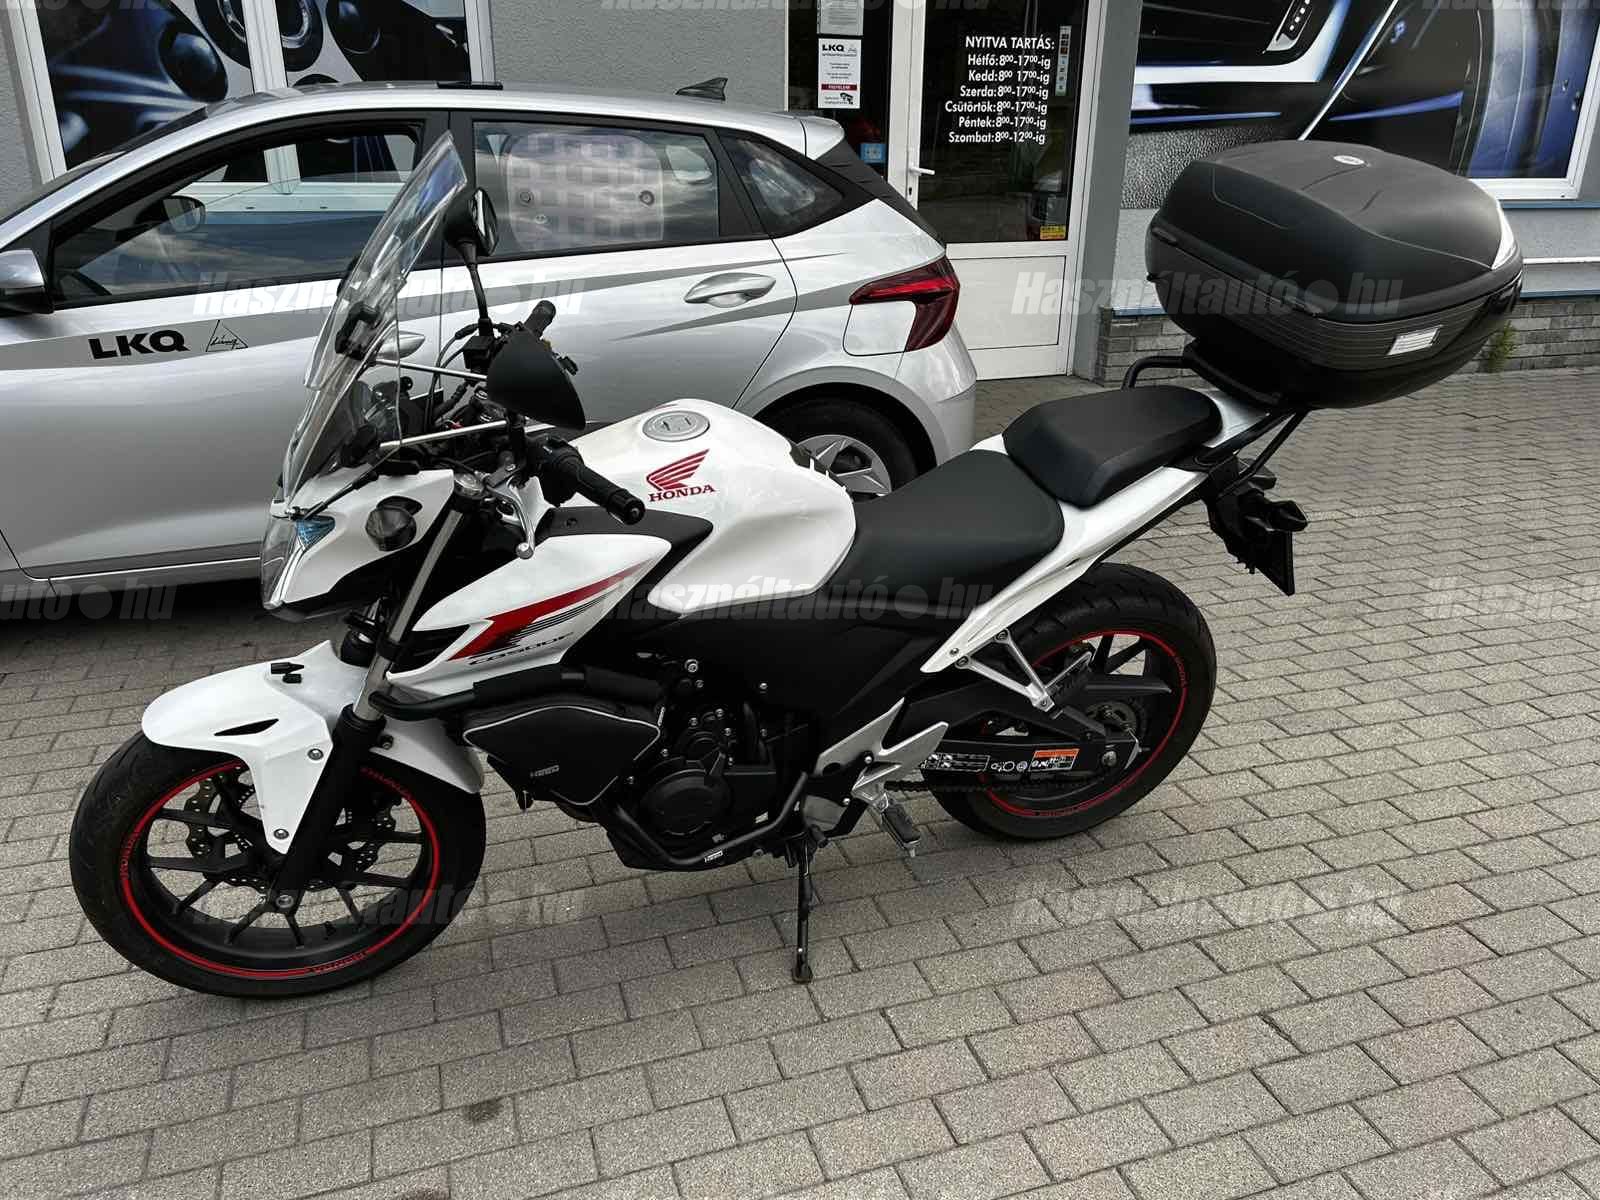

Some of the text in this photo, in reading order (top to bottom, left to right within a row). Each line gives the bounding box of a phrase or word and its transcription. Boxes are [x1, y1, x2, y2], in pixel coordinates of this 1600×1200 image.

[822, 44, 844, 52] LKQ
[965, 34, 1055, 50] NYITVA TARTÁS:
[88, 330, 190, 360] LKQ
[648, 485, 716, 502] HONDA
